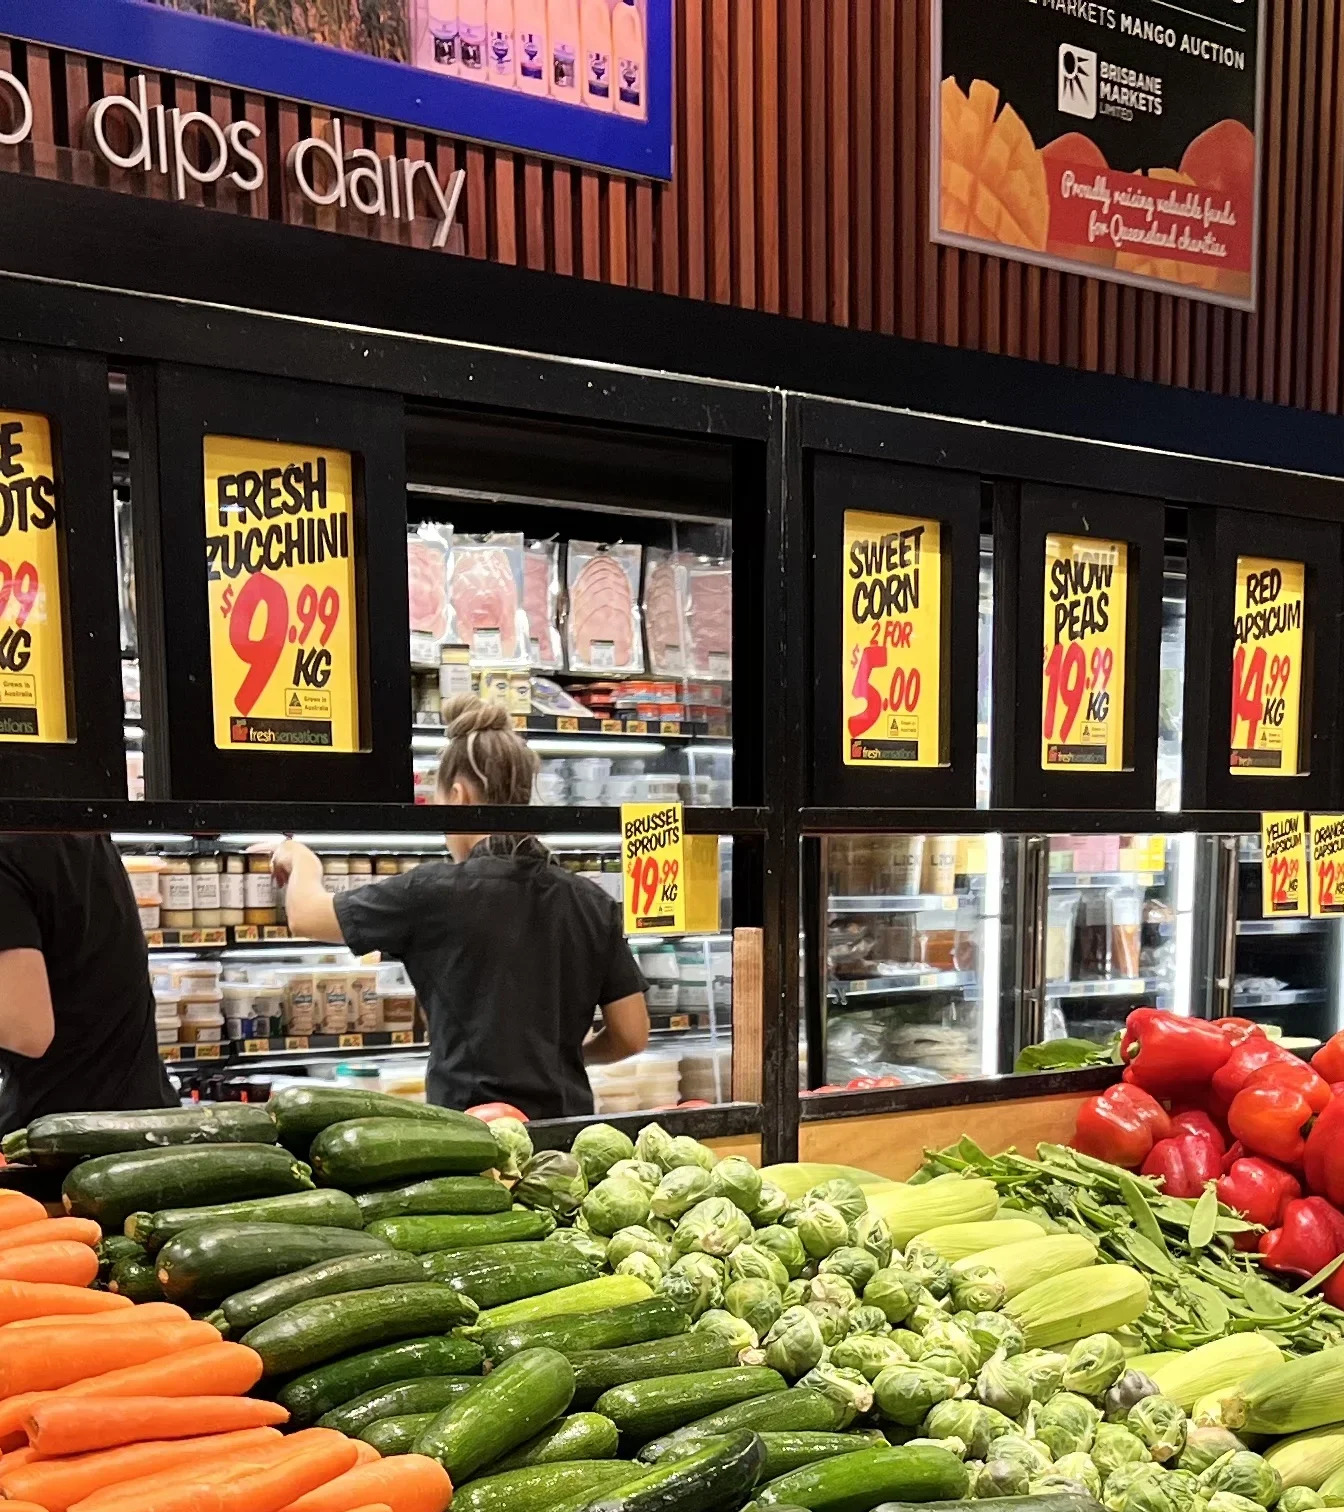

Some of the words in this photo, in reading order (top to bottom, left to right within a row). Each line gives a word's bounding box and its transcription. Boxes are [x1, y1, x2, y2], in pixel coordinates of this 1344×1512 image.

[1043, 0, 1116, 28] MARKETS
[1121, 15, 1176, 48] MANGO
[1180, 34, 1245, 69] AUCTION
[1100, 61, 1162, 95] BRISBANE
[1100, 82, 1162, 115] MARKETS
[84, 74, 264, 199] dips
[286, 119, 467, 248] dairy
[218, 457, 327, 526] FRESH
[207, 512, 349, 581] ZUCCHINI
[849, 526, 925, 578] SWEET
[1050, 546, 1116, 602] SNOW
[1246, 568, 1281, 608] RED
[852, 570, 919, 624] CORN
[870, 624, 880, 646] 2
[884, 621, 912, 648] FOR
[1055, 592, 1108, 645] PEAS
[1234, 600, 1300, 644] APSICUM
[293, 647, 331, 687] KG
[1086, 691, 1109, 722] KG
[1263, 698, 1285, 726] KG
[625, 807, 679, 839] BRUSSEL
[1267, 815, 1299, 841] YELLOW
[627, 826, 679, 859] SPROUTS
[1266, 833, 1302, 858] CAPSICUM
[661, 884, 678, 902] KG
[1289, 879, 1298, 891] KG
[1335, 882, 1344, 894] KG
